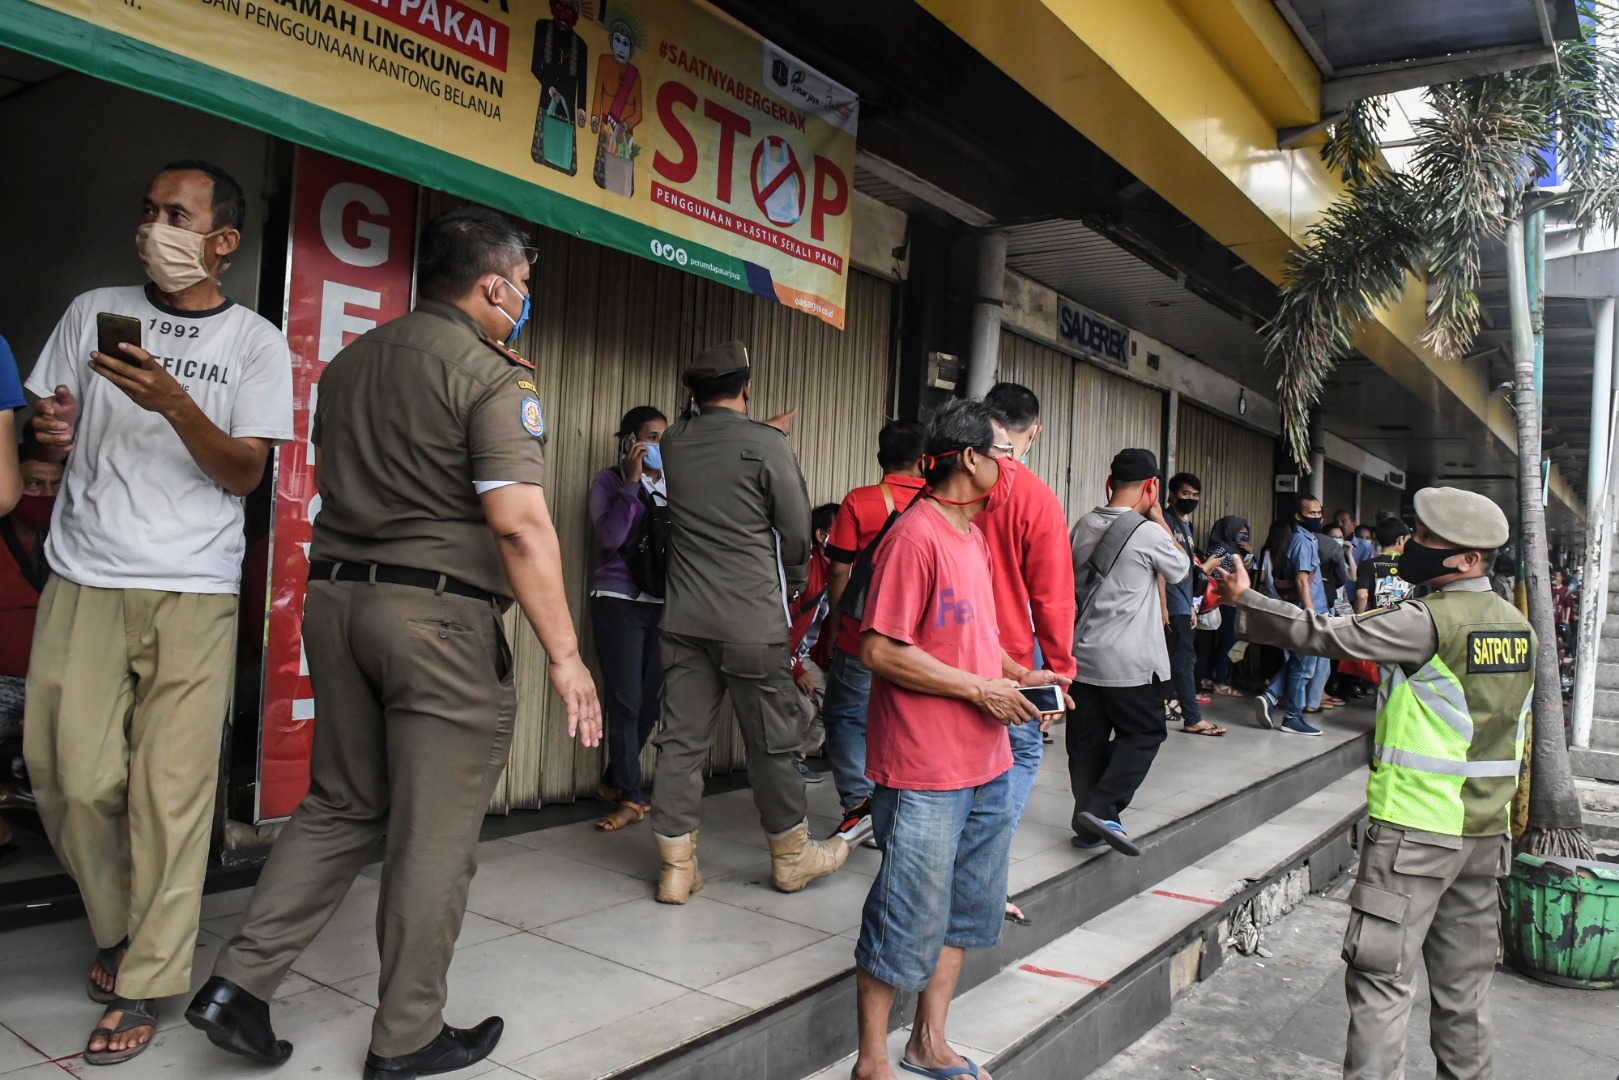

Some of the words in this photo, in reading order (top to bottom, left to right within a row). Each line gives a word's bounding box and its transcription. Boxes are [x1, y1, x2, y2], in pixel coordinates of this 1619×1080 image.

[203, 0, 240, 17] AN
[245, 3, 364, 67] PENGGUNAAN
[368, 53, 441, 97] KANTONG
[444, 84, 502, 122] BELANJA
[276, 0, 357, 36] AMAH
[363, 20, 504, 98] LINGKUNGAN
[399, 0, 497, 56] PAKAI
[658, 40, 807, 134] #SAATNYABERGERAK
[652, 80, 849, 242] STOP
[656, 187, 732, 229] PENGGUNAAN
[735, 221, 778, 245] PLASTIK
[780, 236, 812, 259] SEKALI
[814, 251, 839, 270] PAKAI
[149, 318, 200, 339] 1992
[1059, 305, 1128, 364] SADEREK
